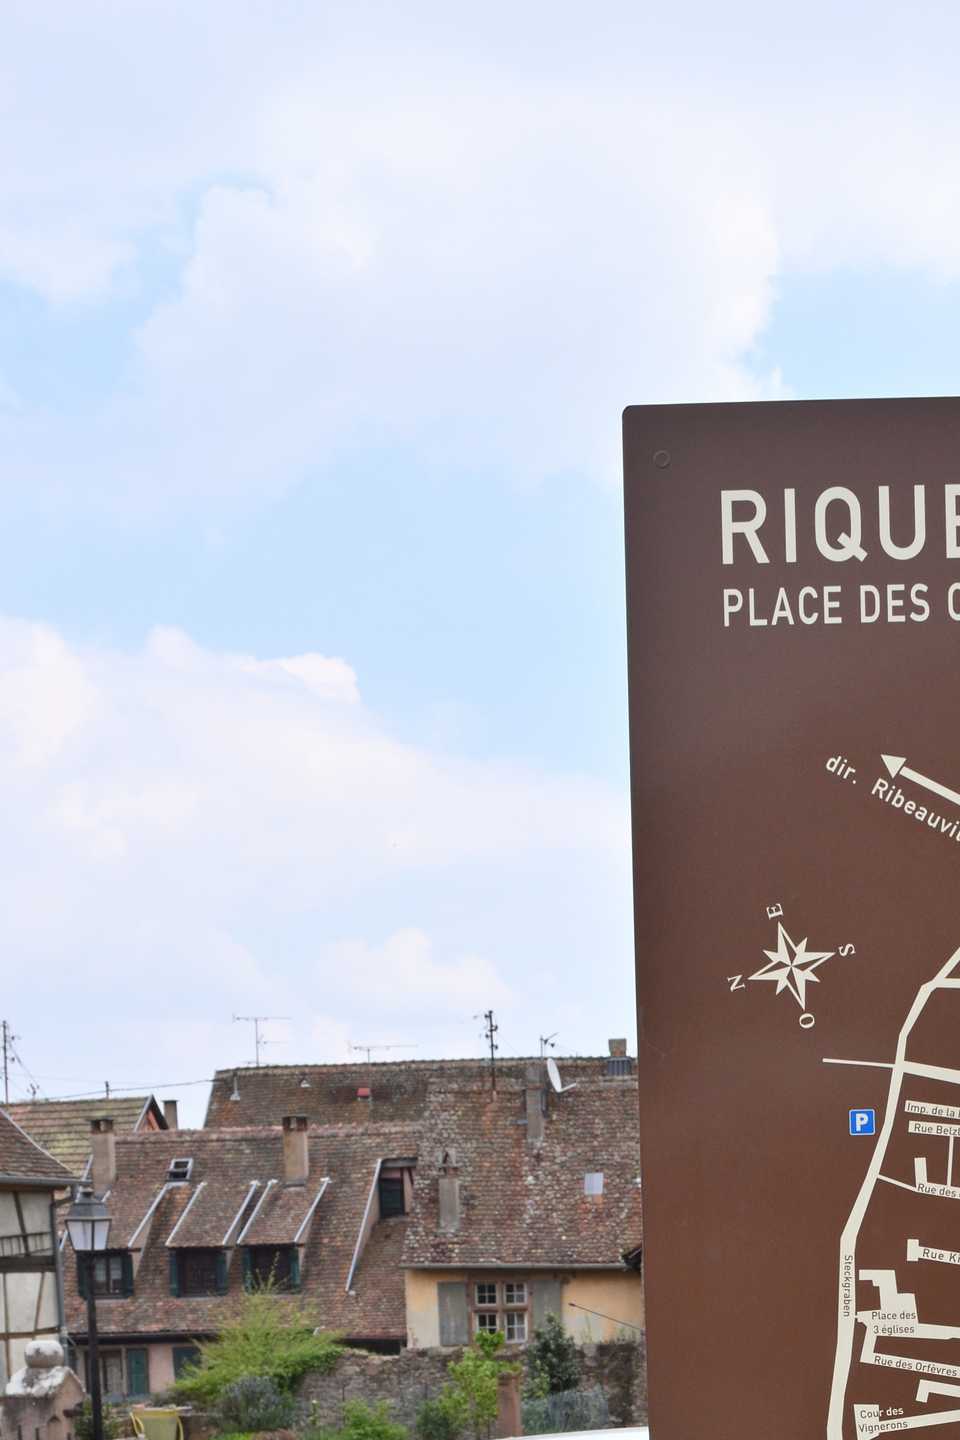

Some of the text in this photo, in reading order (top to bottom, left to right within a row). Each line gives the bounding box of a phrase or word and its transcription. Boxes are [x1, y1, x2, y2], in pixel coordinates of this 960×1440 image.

[723, 585, 841, 627] PLACE
[860, 582, 930, 623] DES
[826, 756, 856, 784] dir.
[766, 903, 783, 919] E
[839, 943, 856, 956] S
[728, 974, 745, 991] N
[800, 1014, 815, 1028] O
[932, 1107, 943, 1115] de
[947, 1108, 955, 1117] la
[914, 1124, 933, 1134] Rue
[918, 1183, 936, 1194] Rue
[939, 1186, 956, 1197] des
[923, 1249, 944, 1259] Rue
[843, 1255, 853, 1317] Steckgraben
[900, 1311, 916, 1319] des
[882, 1325, 914, 1335] églises
[874, 1356, 957, 1377] Rue des Orfèvres
[860, 1407, 903, 1419] Cour des
[859, 1420, 908, 1433] Vignerons
